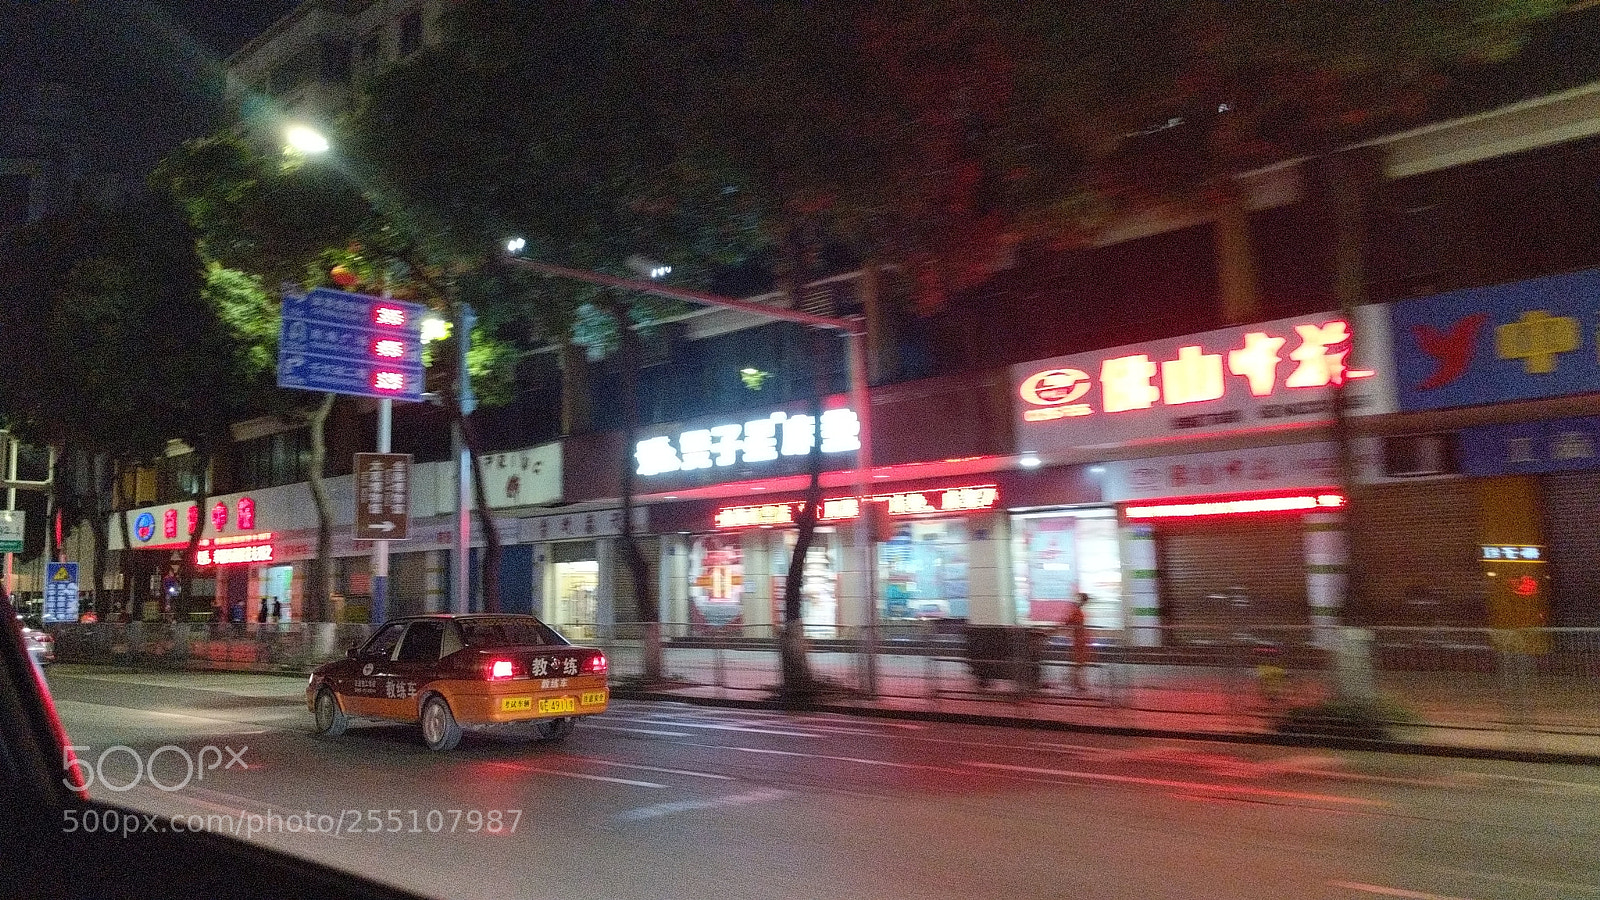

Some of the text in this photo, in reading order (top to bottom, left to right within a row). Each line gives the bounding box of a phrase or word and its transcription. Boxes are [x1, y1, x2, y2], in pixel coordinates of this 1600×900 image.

[532, 657, 578, 677] 教练
[386, 679, 417, 700] 教练车
[540, 678, 569, 689] 教练车
[505, 699, 530, 709] 考试车辆
